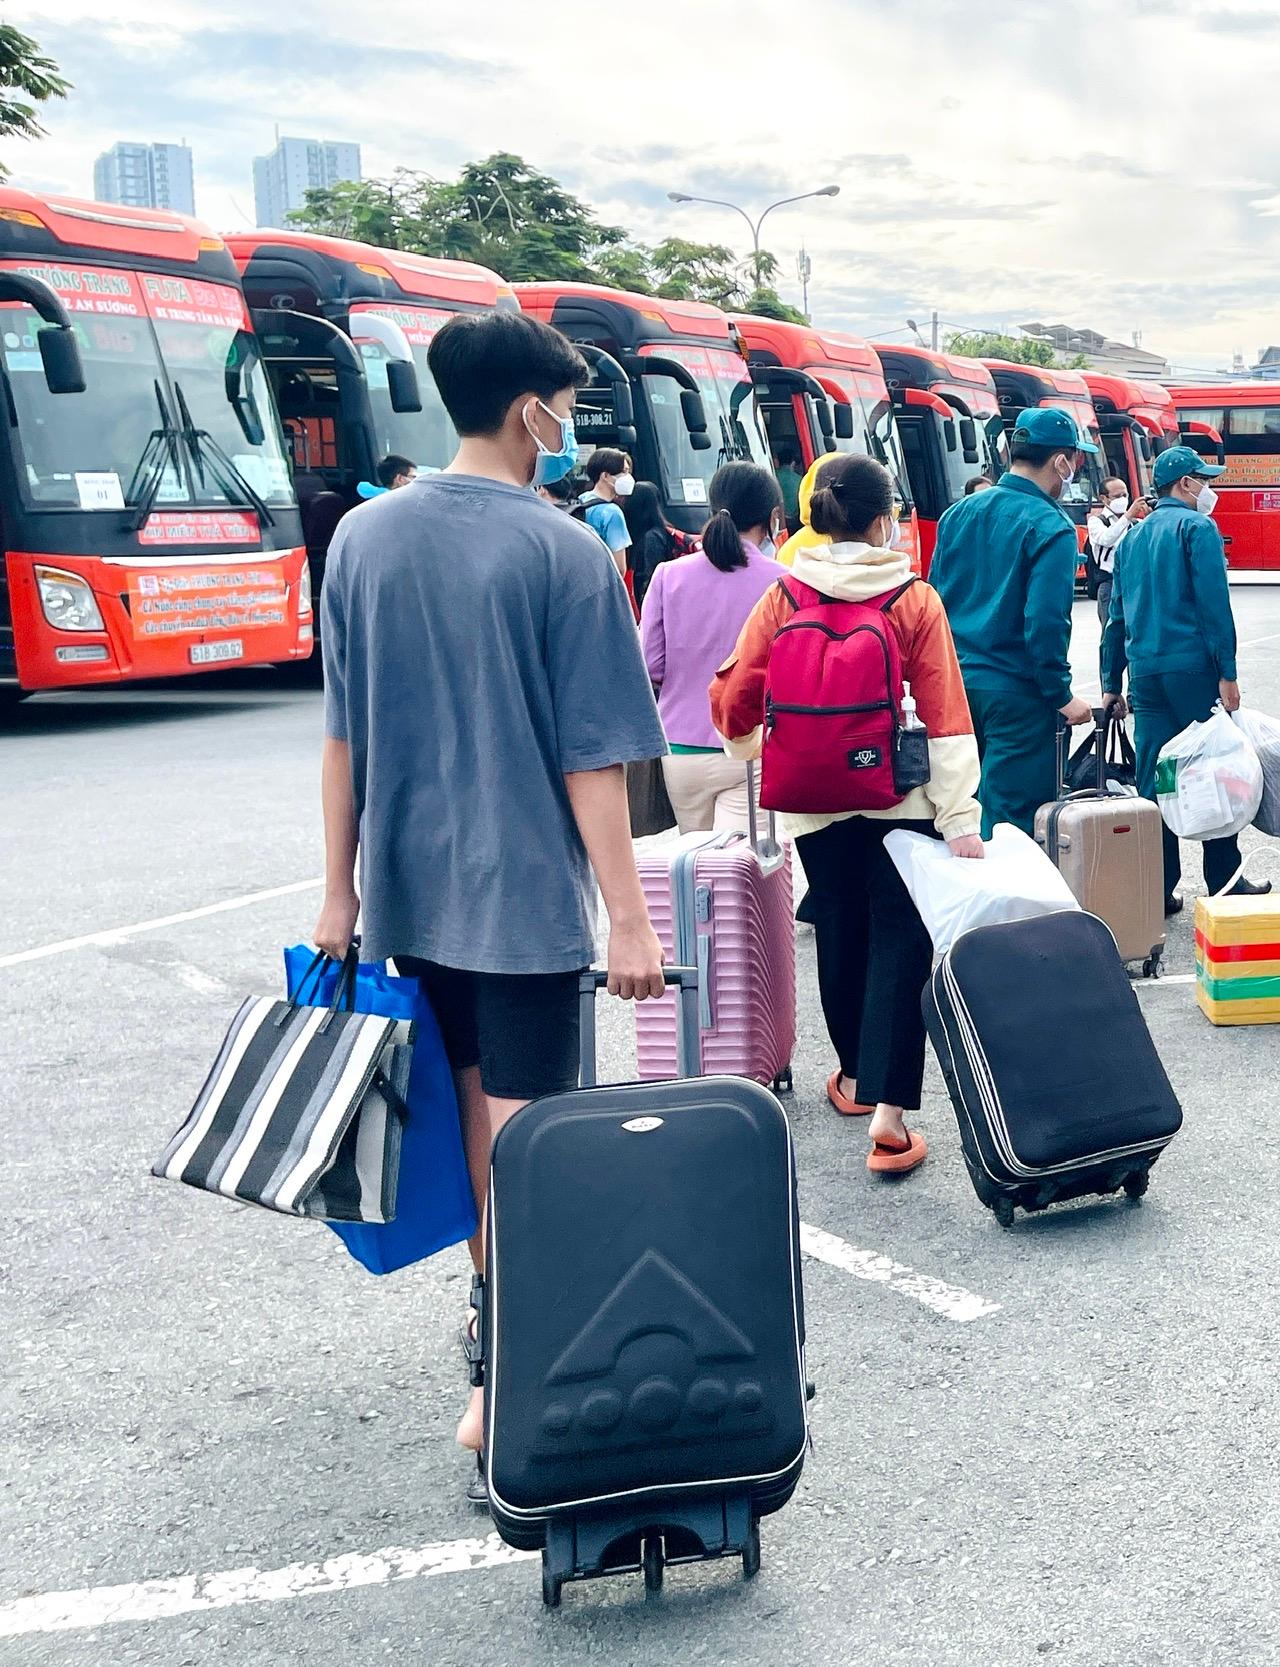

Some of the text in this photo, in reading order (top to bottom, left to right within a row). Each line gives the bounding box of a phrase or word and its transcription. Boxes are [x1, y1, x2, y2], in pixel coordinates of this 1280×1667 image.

[82, 272, 131, 296] TRANG
[145, 277, 192, 304] FUTA
[576, 413, 613, 426] 51B-308.21
